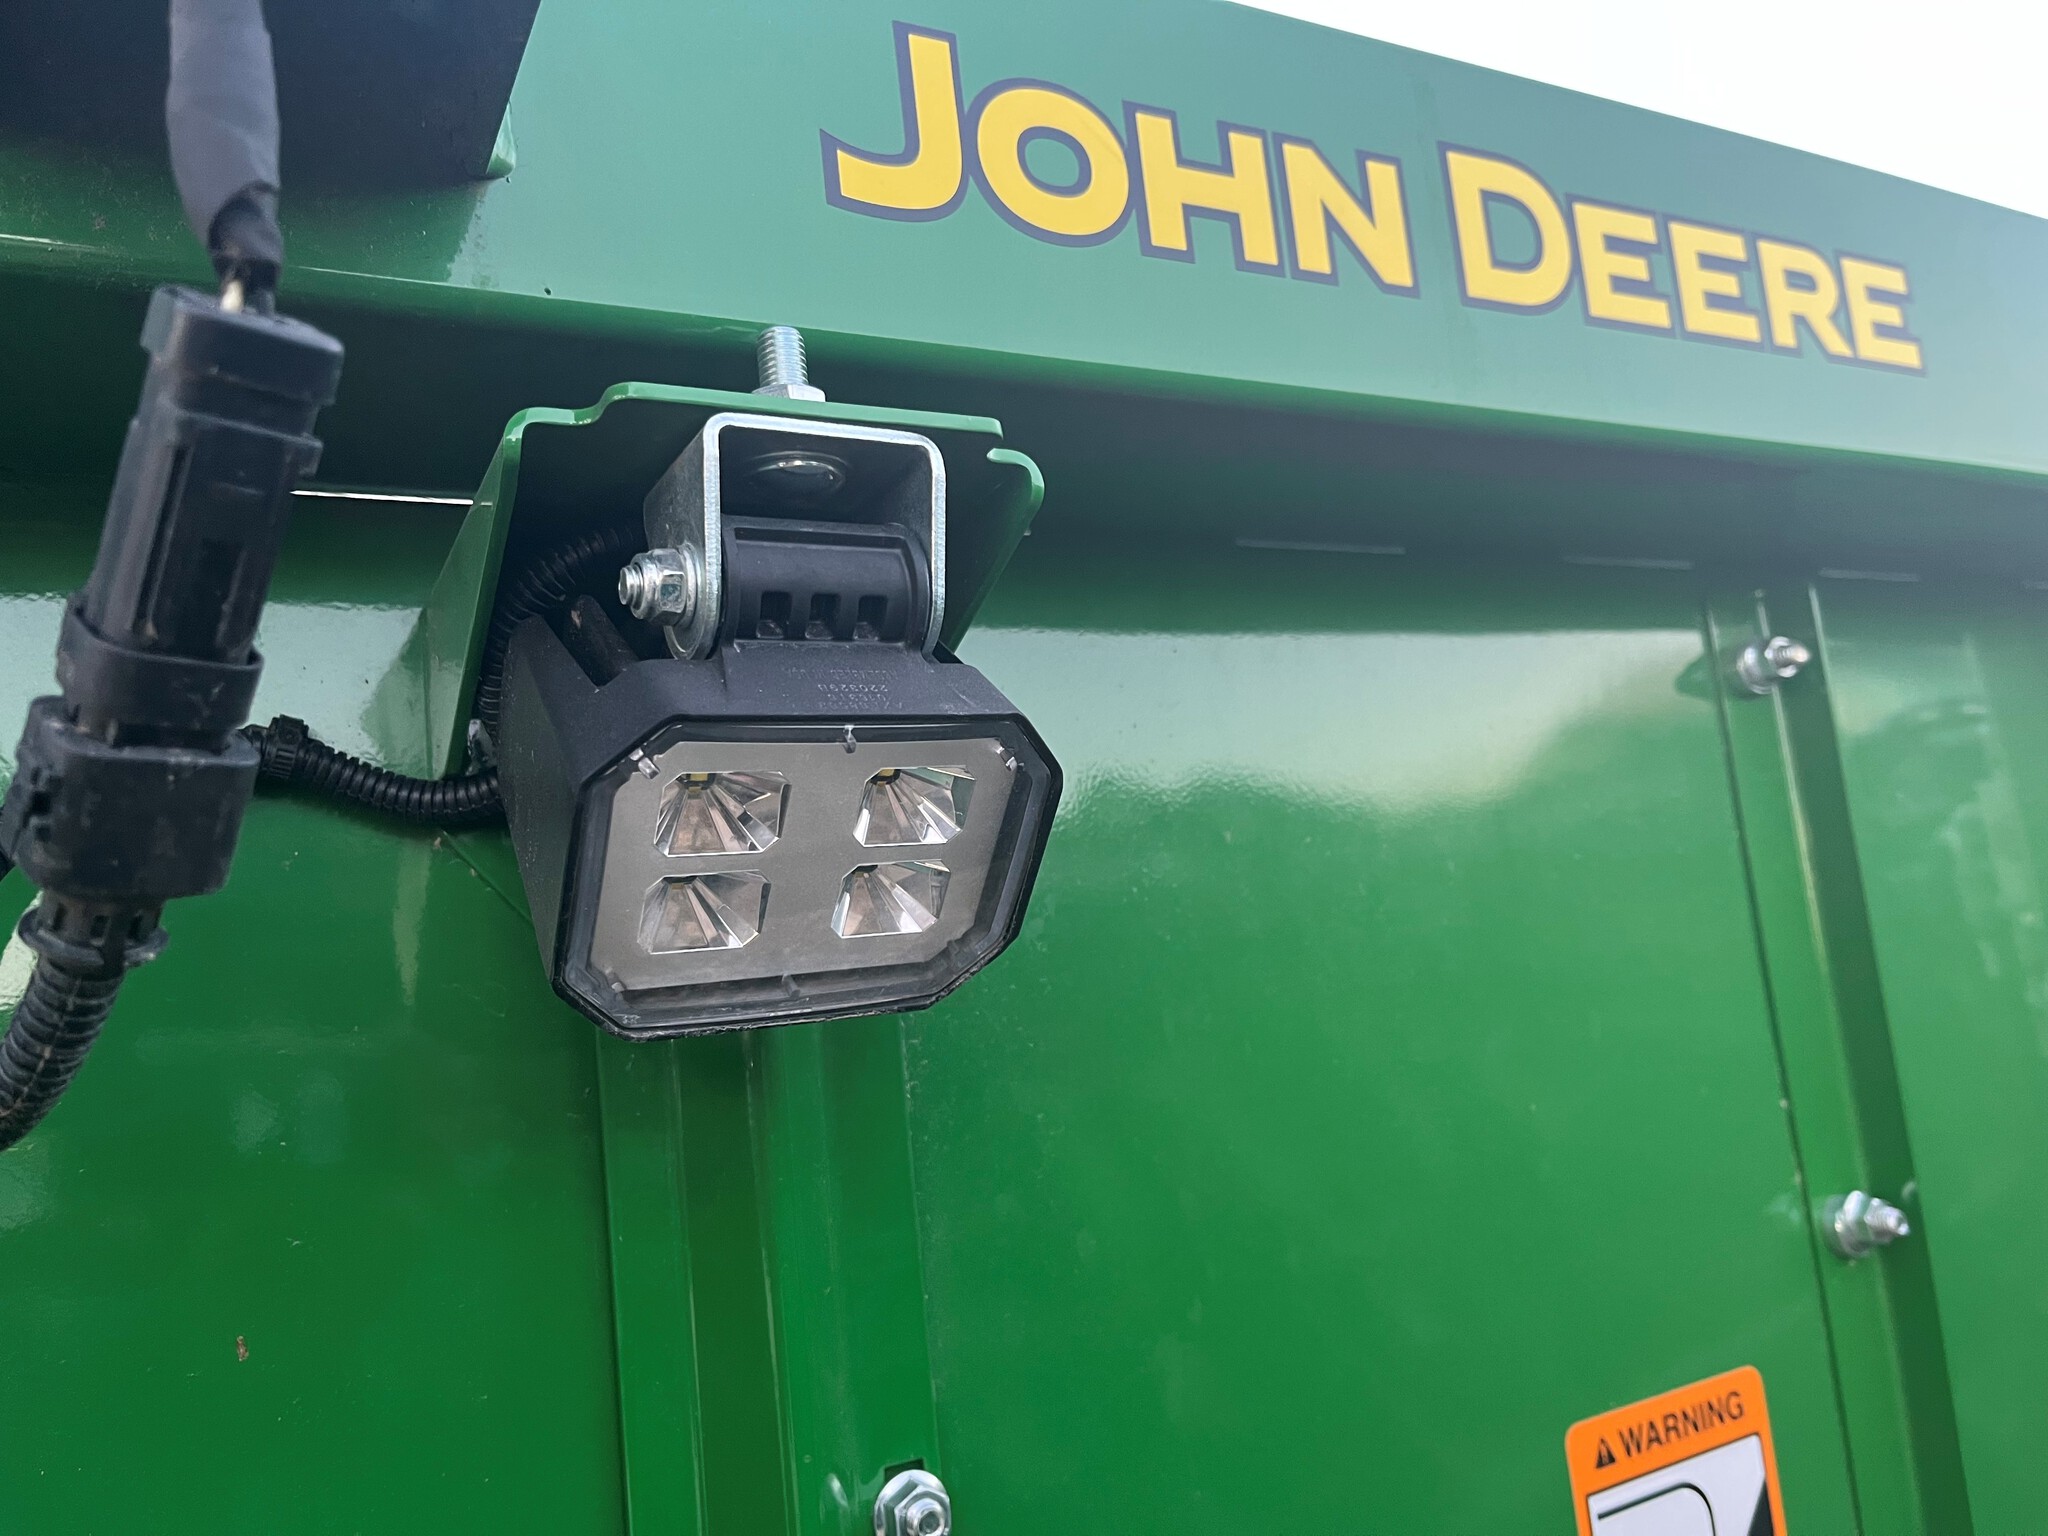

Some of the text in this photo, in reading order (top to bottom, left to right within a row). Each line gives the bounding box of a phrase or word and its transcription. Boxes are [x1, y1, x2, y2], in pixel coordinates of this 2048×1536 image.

[822, 23, 1925, 374] JOHN DEERE
[1618, 1392, 1743, 1457] WARNING
